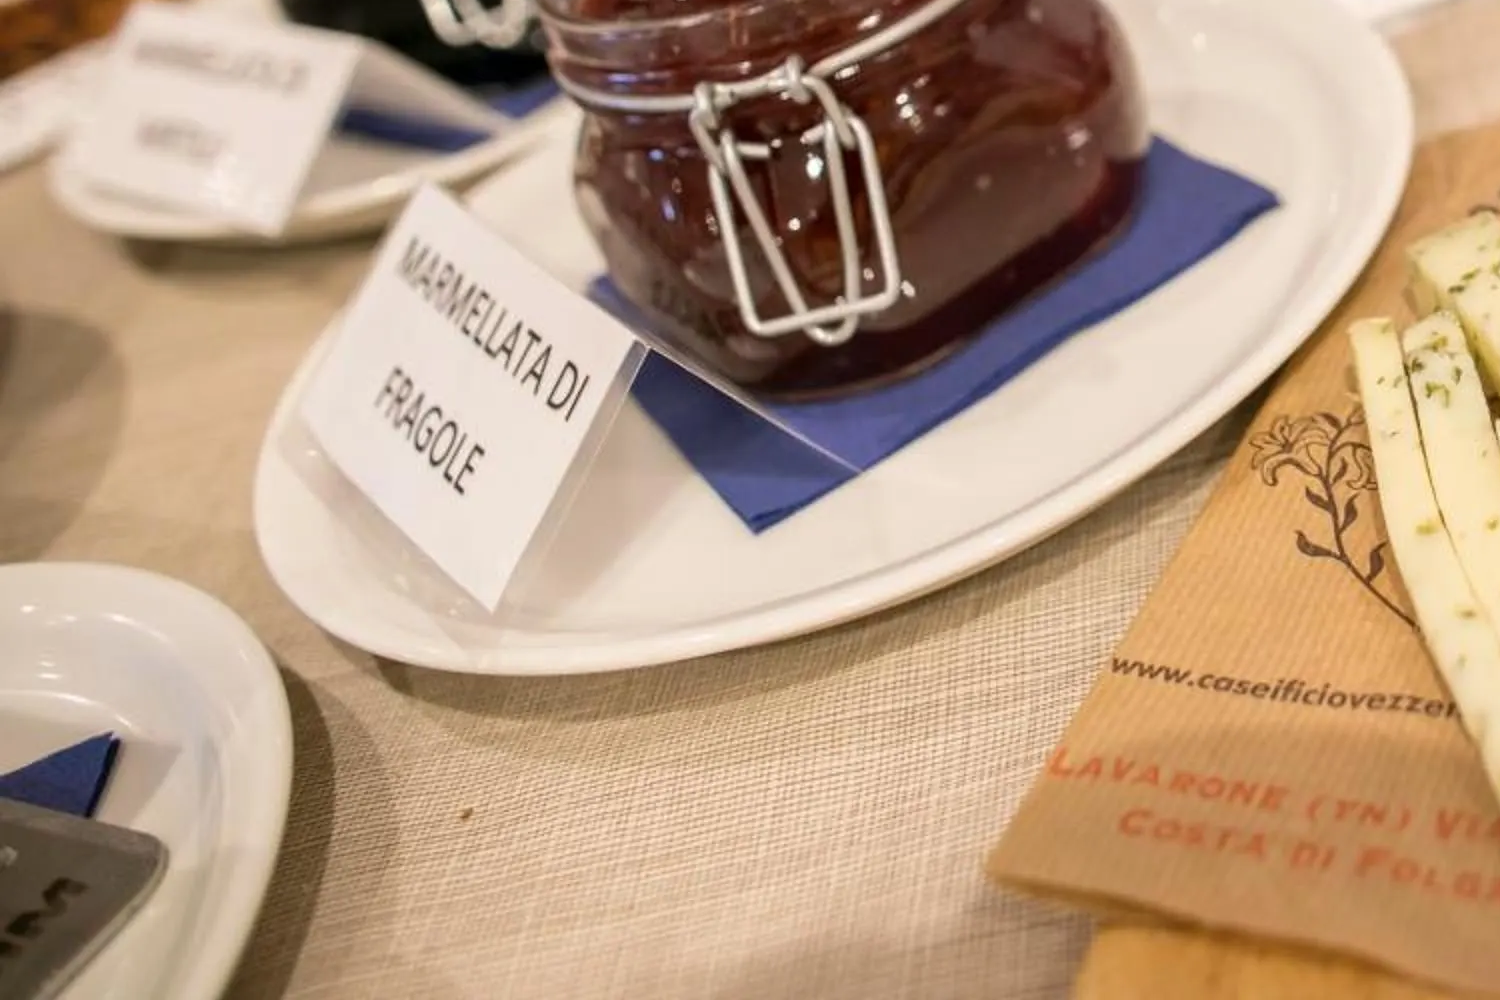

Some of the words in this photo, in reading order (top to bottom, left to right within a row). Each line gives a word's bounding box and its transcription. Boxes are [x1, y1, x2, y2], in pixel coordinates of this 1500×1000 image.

[398, 236, 552, 396] MARMELLATA
[546, 360, 591, 422] DI
[374, 366, 486, 495] FRAGOLE
[1048, 746, 1290, 812] LAVARONE
[1305, 796, 1412, 832] (TN)
[1117, 804, 1268, 862] COSTA
[1288, 841, 1336, 874] DI
